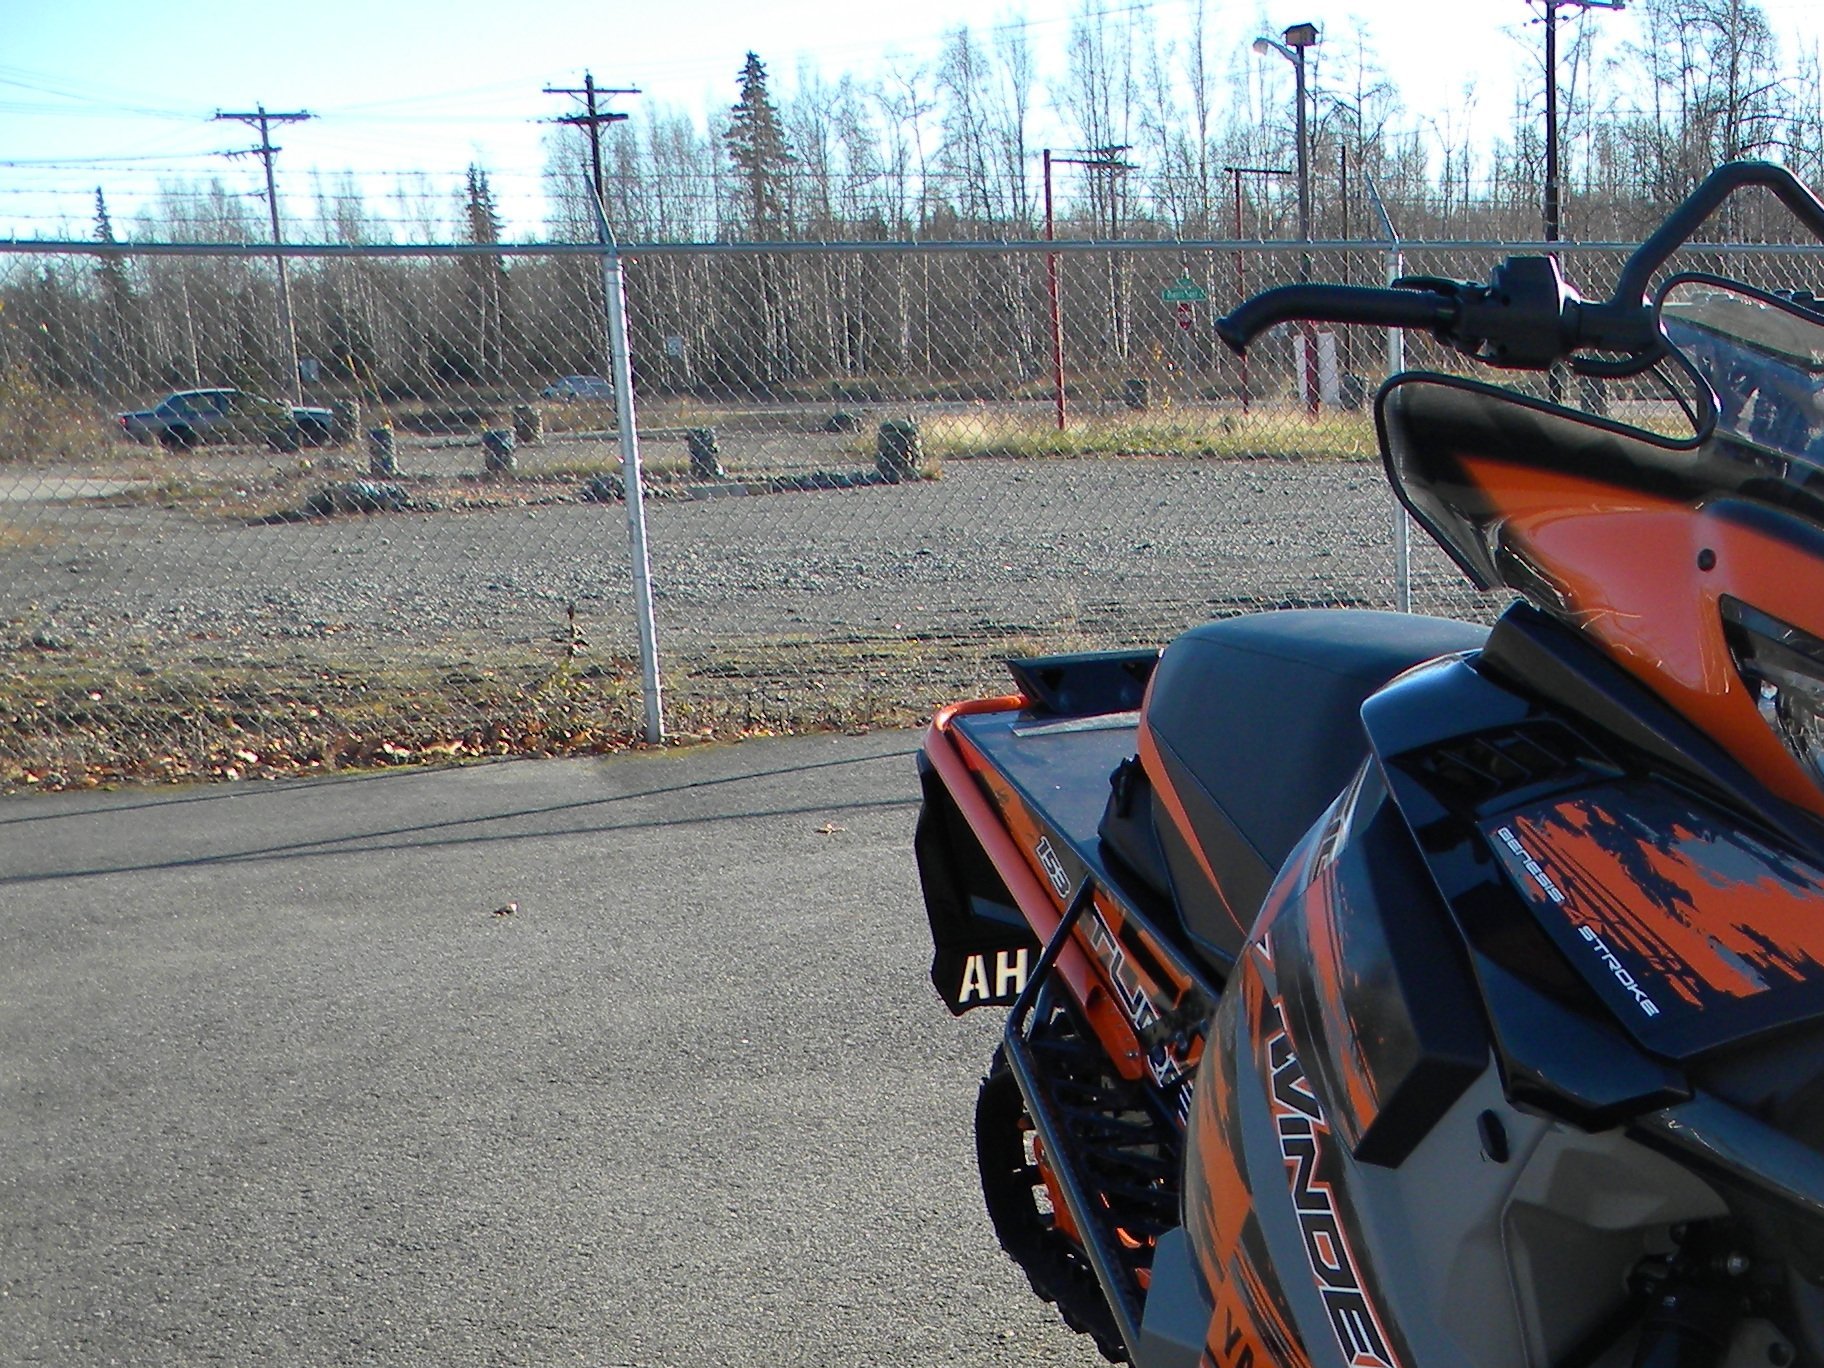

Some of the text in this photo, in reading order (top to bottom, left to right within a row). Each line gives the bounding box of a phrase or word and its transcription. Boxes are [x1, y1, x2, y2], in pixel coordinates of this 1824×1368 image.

[1036, 835, 1071, 899] 153
[958, 946, 1047, 1004] AH
[1578, 924, 1660, 1017] STROKE
